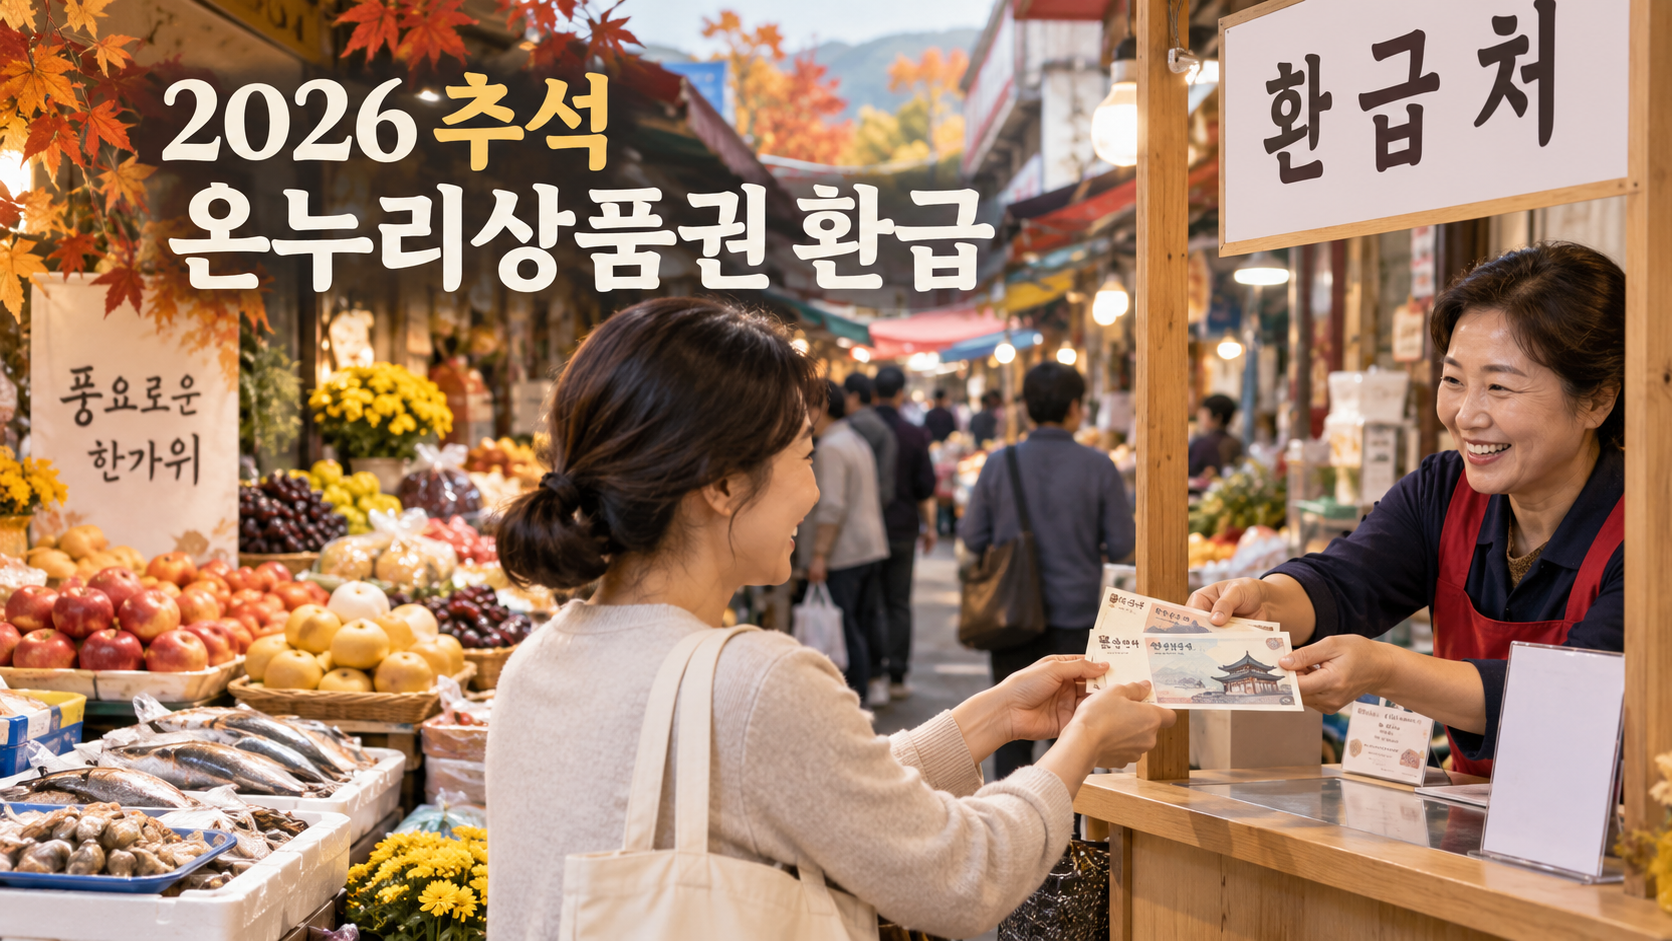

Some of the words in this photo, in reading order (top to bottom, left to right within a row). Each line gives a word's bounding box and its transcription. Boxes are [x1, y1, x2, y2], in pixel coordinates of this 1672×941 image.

[1263, 0, 1556, 184] 환급처
[59, 364, 202, 428] 풍요로운
[87, 433, 201, 486] 한가위
